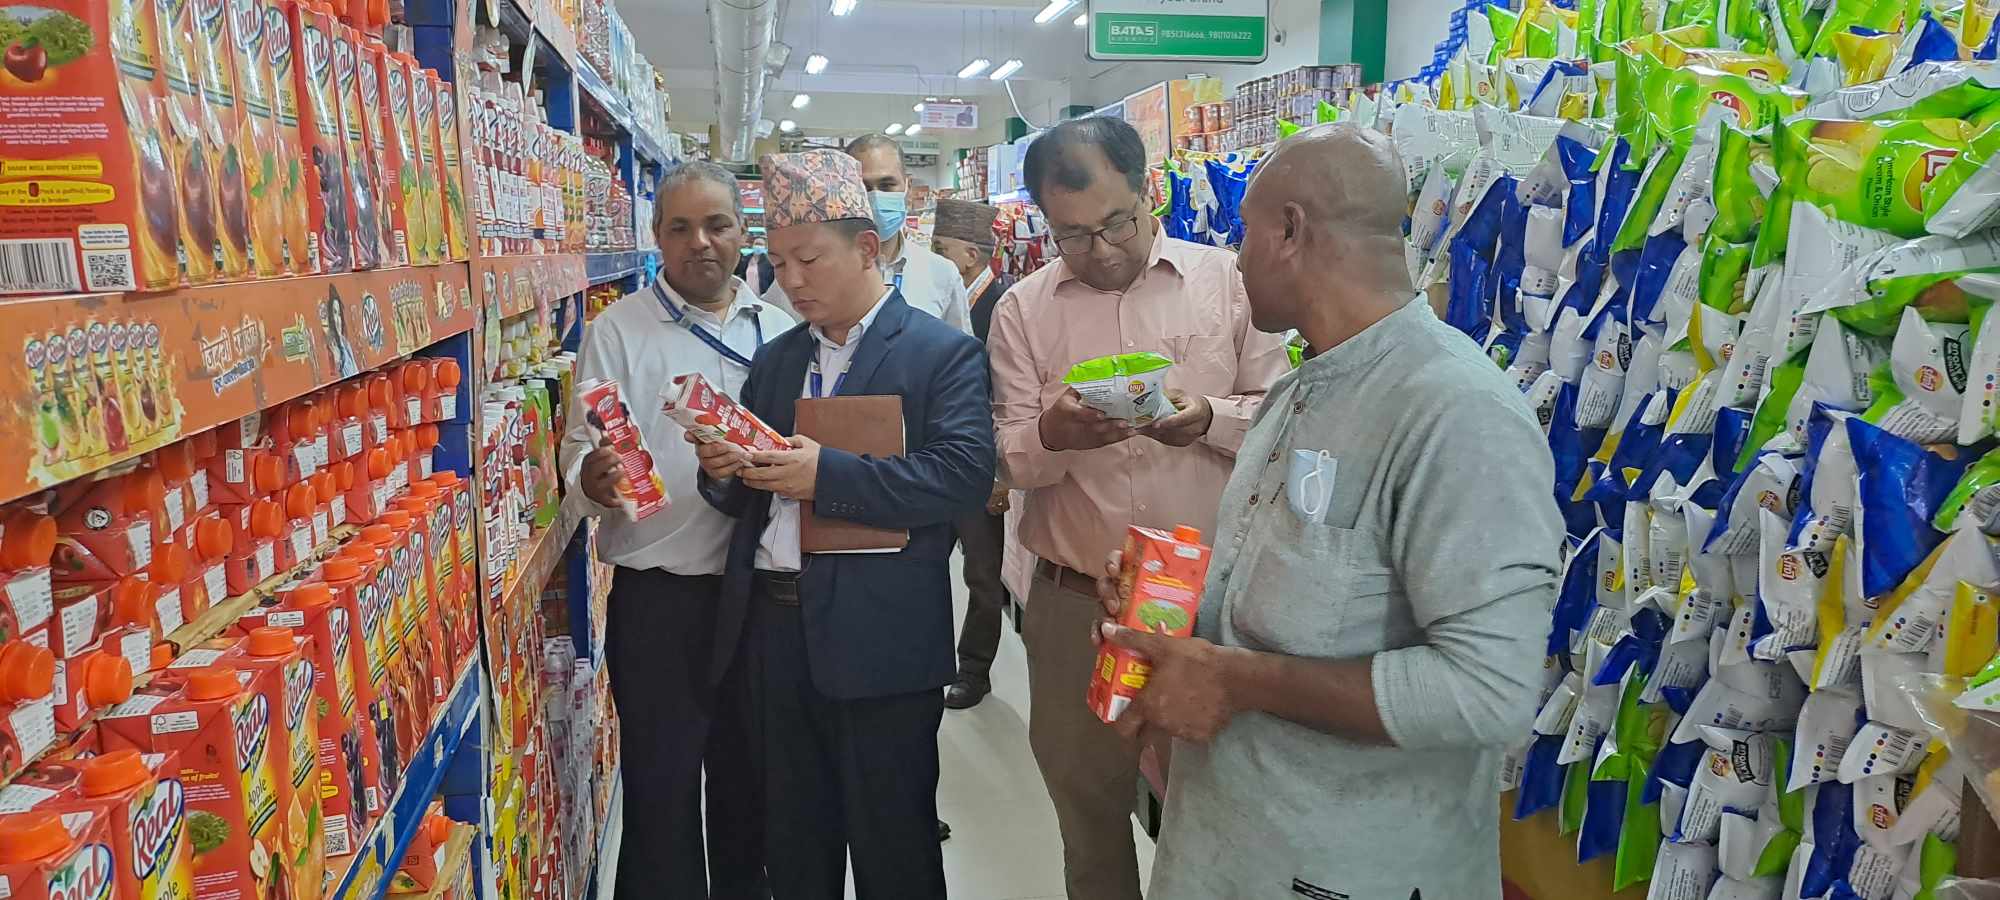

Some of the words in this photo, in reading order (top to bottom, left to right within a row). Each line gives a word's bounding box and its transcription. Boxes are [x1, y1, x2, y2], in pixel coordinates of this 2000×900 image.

[264, 18, 290, 60] Real
[1111, 25, 1154, 36] BATAS
[1782, 555, 1798, 580] Lay's
[286, 661, 309, 731] Real
[236, 694, 267, 768] Real
[248, 778, 266, 808] Apple
[134, 780, 179, 870] Real
[52, 843, 105, 900] al
